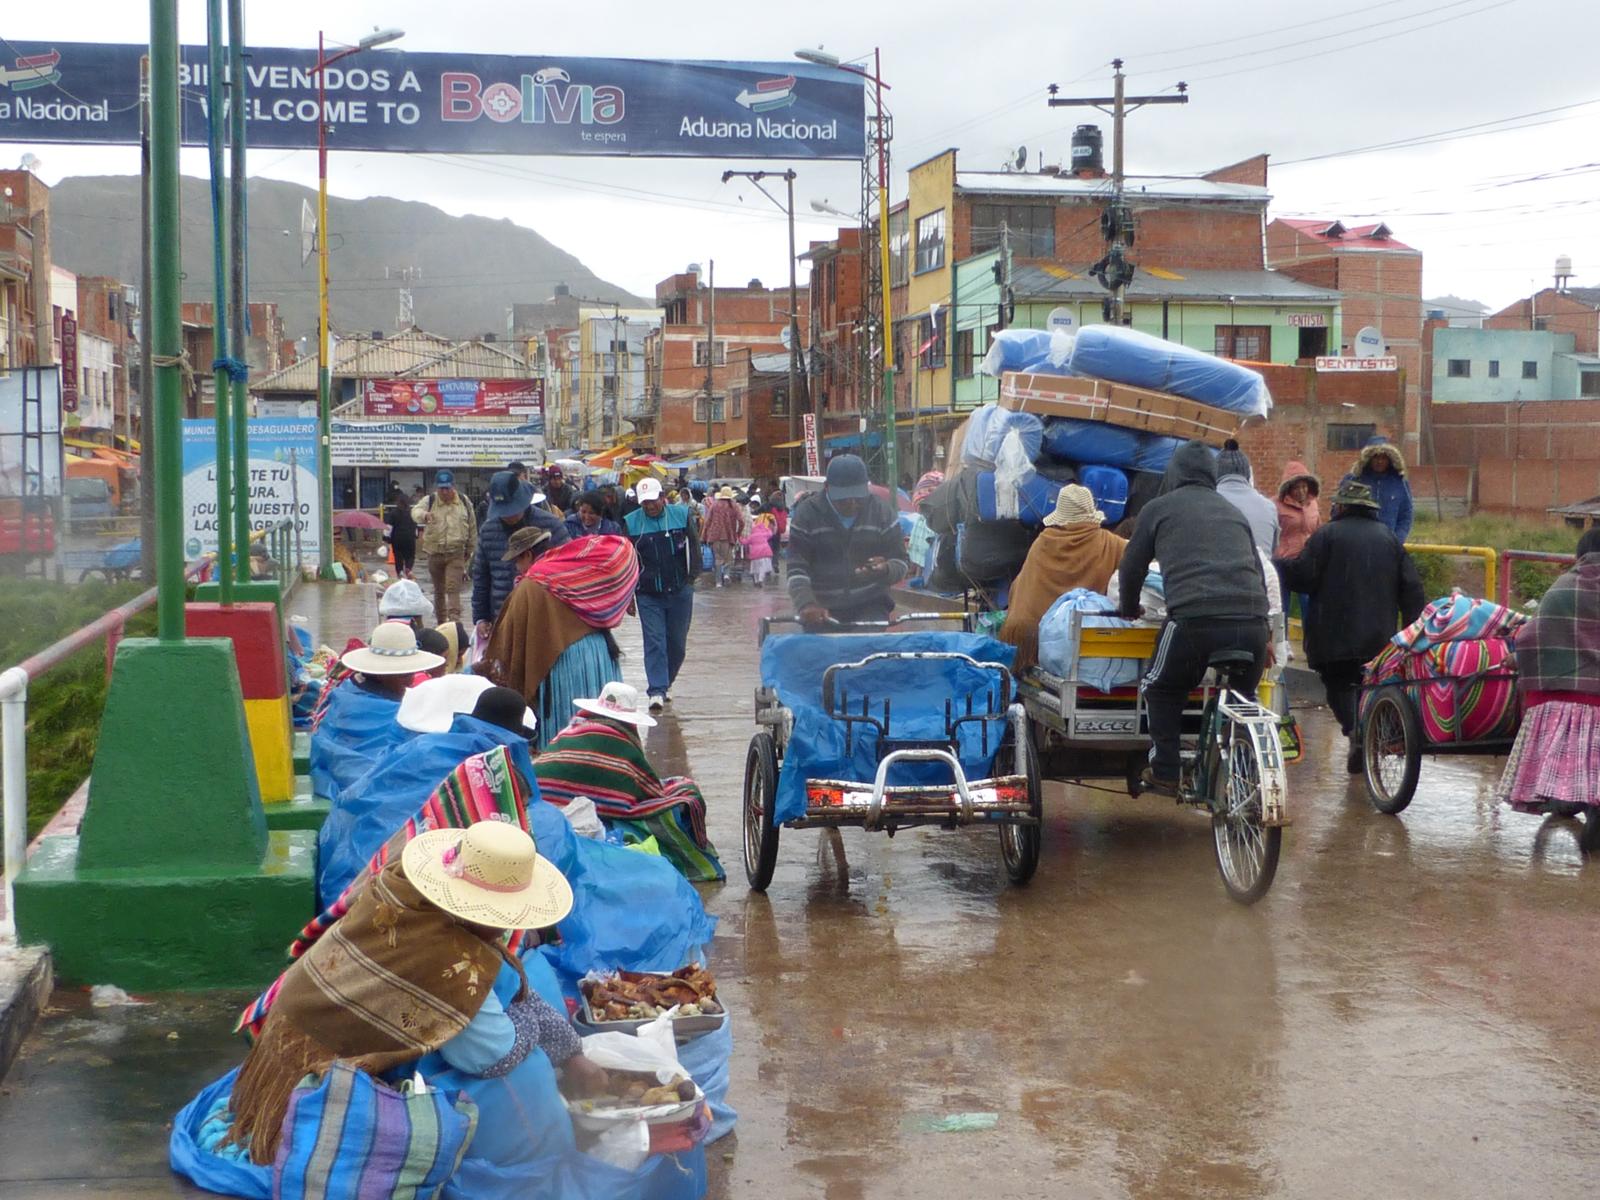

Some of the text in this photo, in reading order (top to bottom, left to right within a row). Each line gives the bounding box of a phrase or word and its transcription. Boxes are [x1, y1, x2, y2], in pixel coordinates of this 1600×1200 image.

[178, 64, 422, 92] BIVENIDOS A
[16, 97, 109, 121] Nacional
[441, 70, 625, 125] Bolivia
[377, 102, 421, 125] TO
[581, 130, 626, 145] te espera
[679, 116, 837, 140] Aduana Nacional
[1316, 358, 1396, 370] DENTISTA
[1075, 721, 1135, 732] EXCEL
